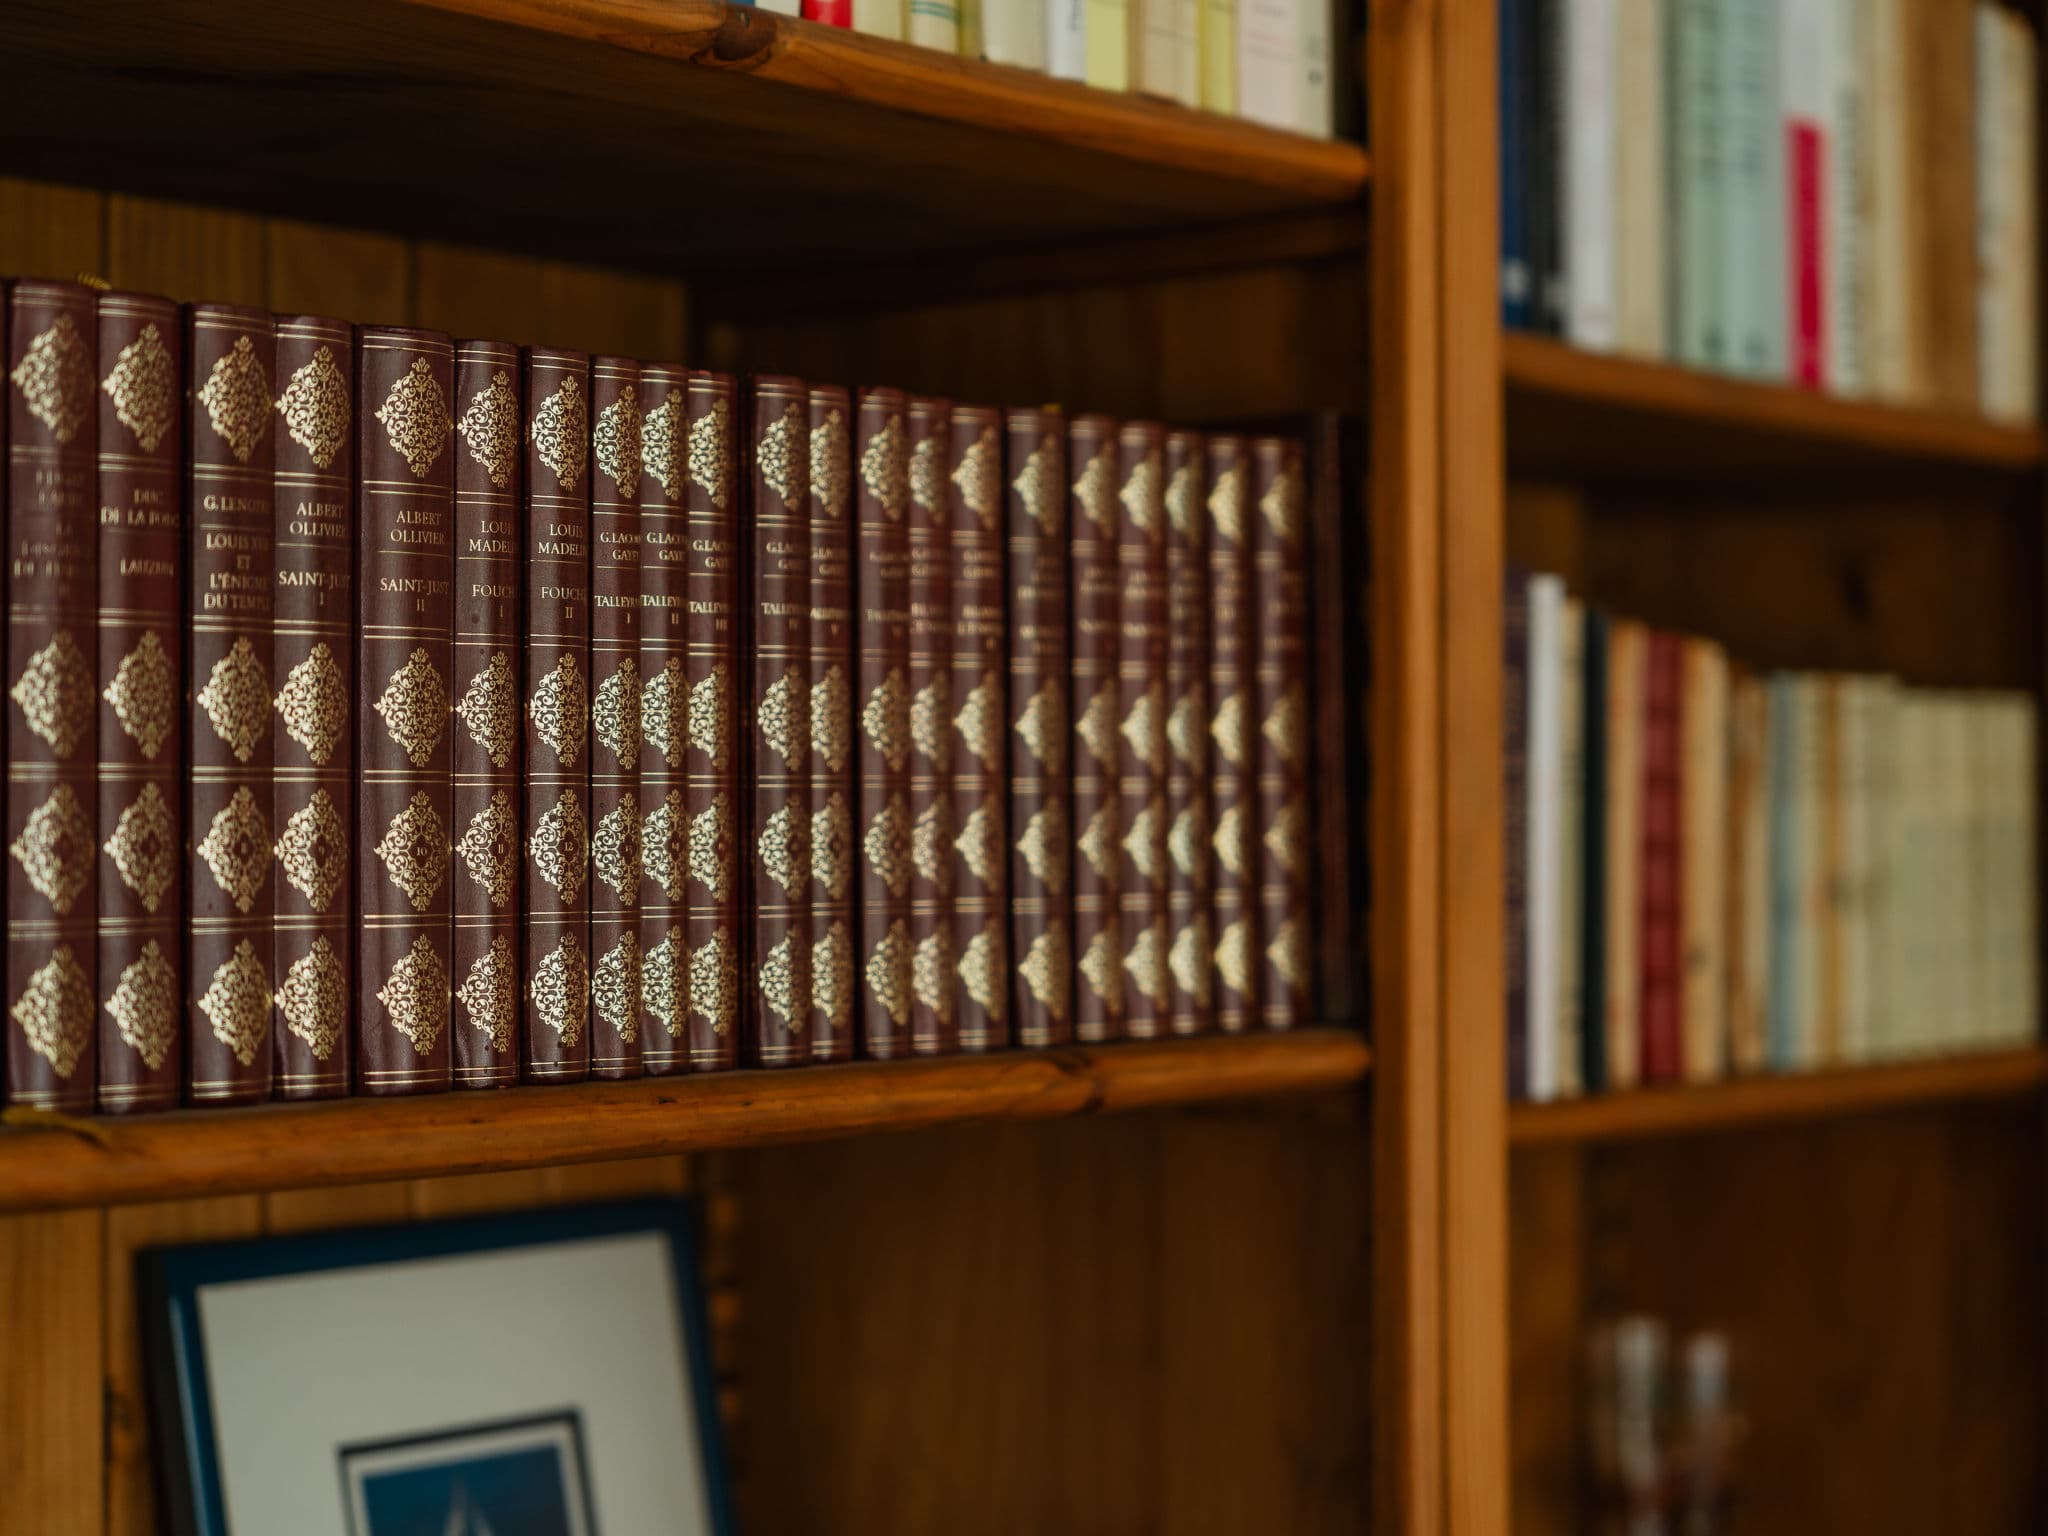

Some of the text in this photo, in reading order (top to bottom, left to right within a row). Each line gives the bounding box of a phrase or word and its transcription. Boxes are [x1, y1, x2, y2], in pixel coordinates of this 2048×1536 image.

[296, 502, 344, 519] ALBERT
[396, 510, 442, 526] ALBERT
[390, 528, 446, 545] OLLIVIER
[550, 523, 585, 538] LOUIS
[469, 539, 514, 554] MADEL
[380, 577, 449, 596] SAINT-JUST
[472, 584, 515, 599] FOUCH
[541, 586, 585, 601] FOUCH
[416, 599, 425, 612] II
[565, 606, 574, 619] II
[416, 847, 428, 857] 10
[564, 842, 574, 852] 12
